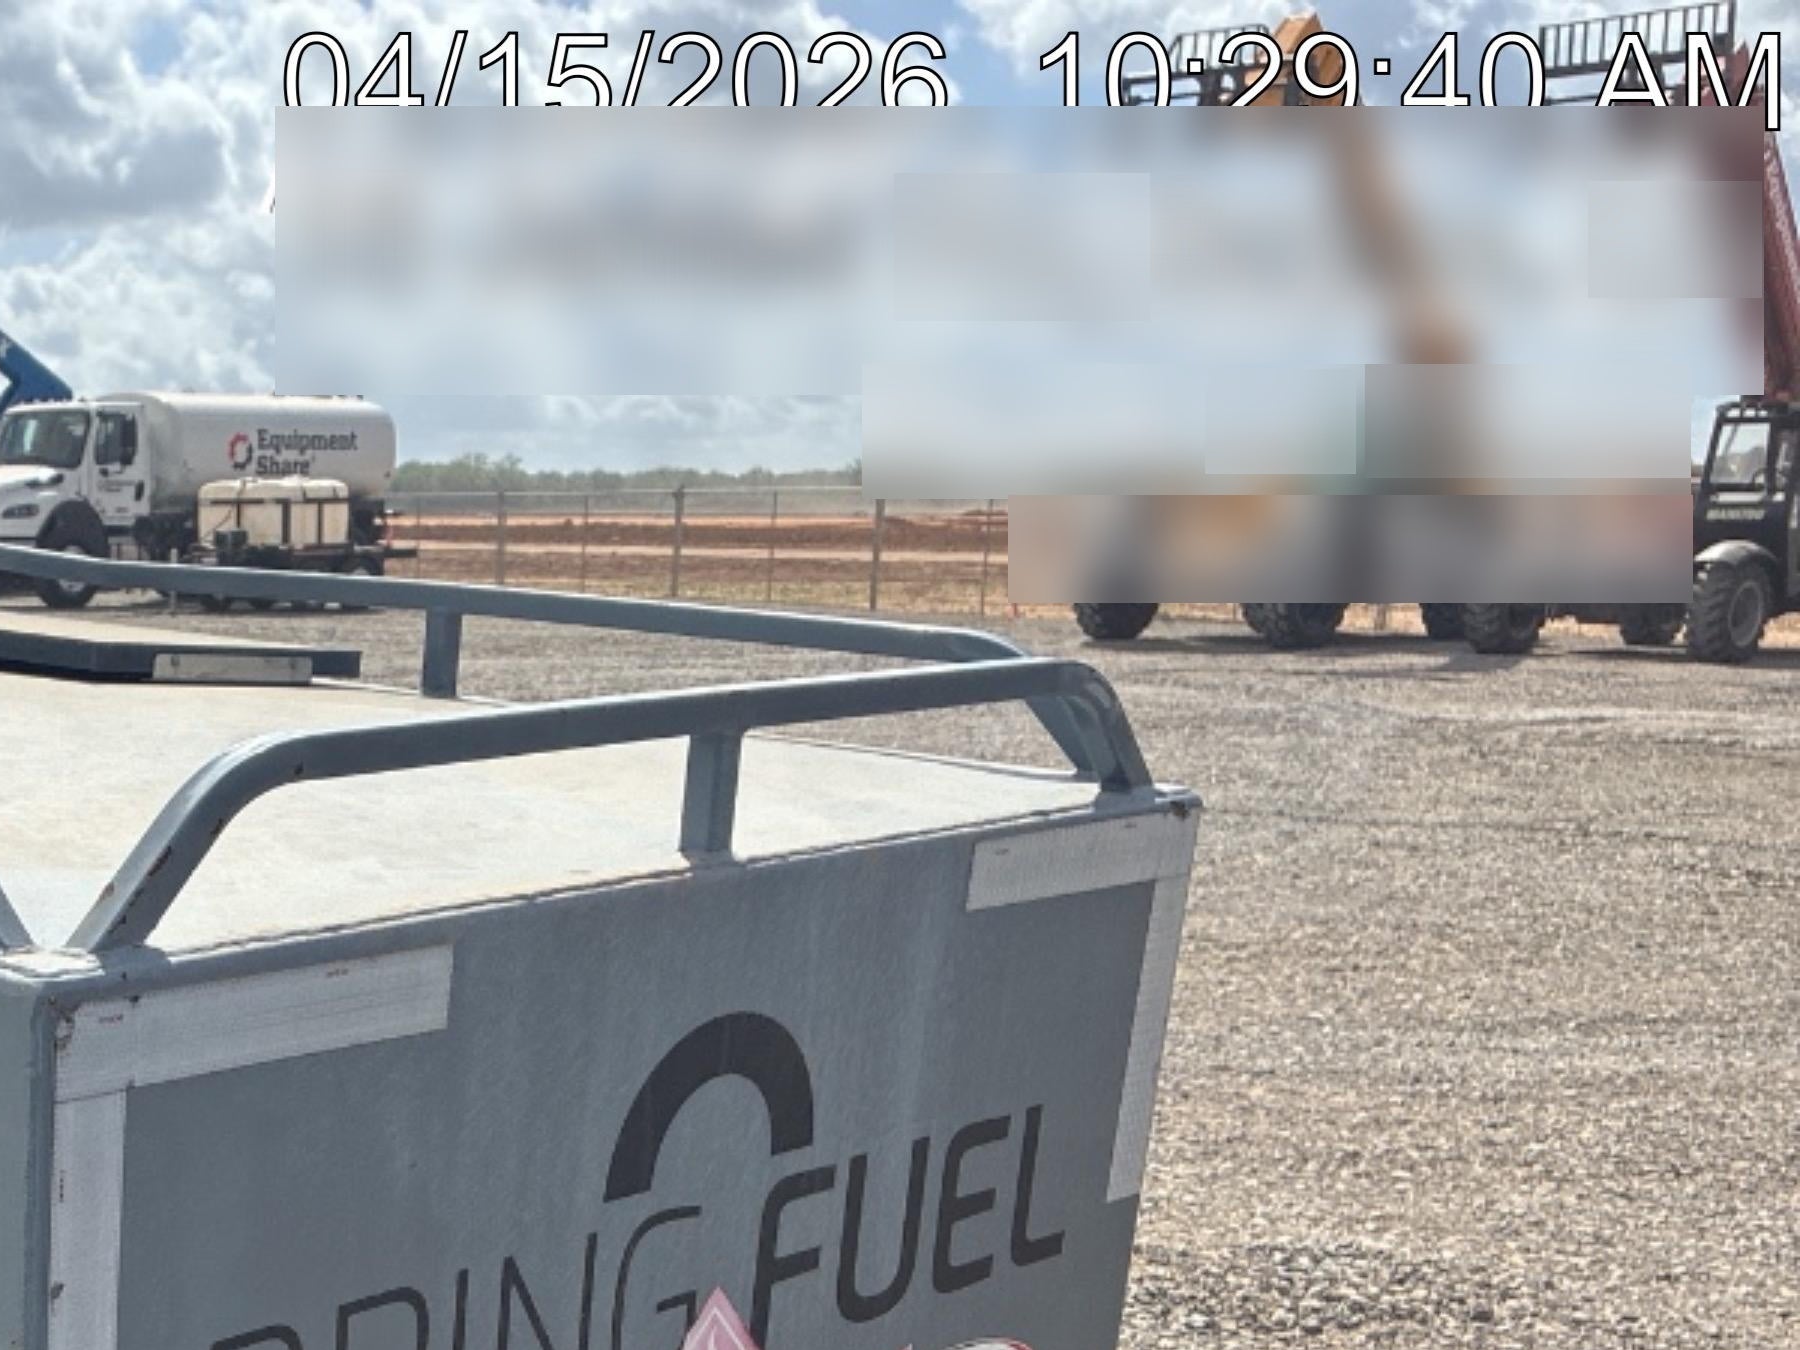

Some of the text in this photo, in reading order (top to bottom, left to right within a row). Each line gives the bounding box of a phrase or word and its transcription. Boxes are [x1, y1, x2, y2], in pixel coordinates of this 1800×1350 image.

[256, 428, 358, 455] Equipment
[255, 455, 310, 475] Share
[750, 1104, 1065, 1349] FUEL
